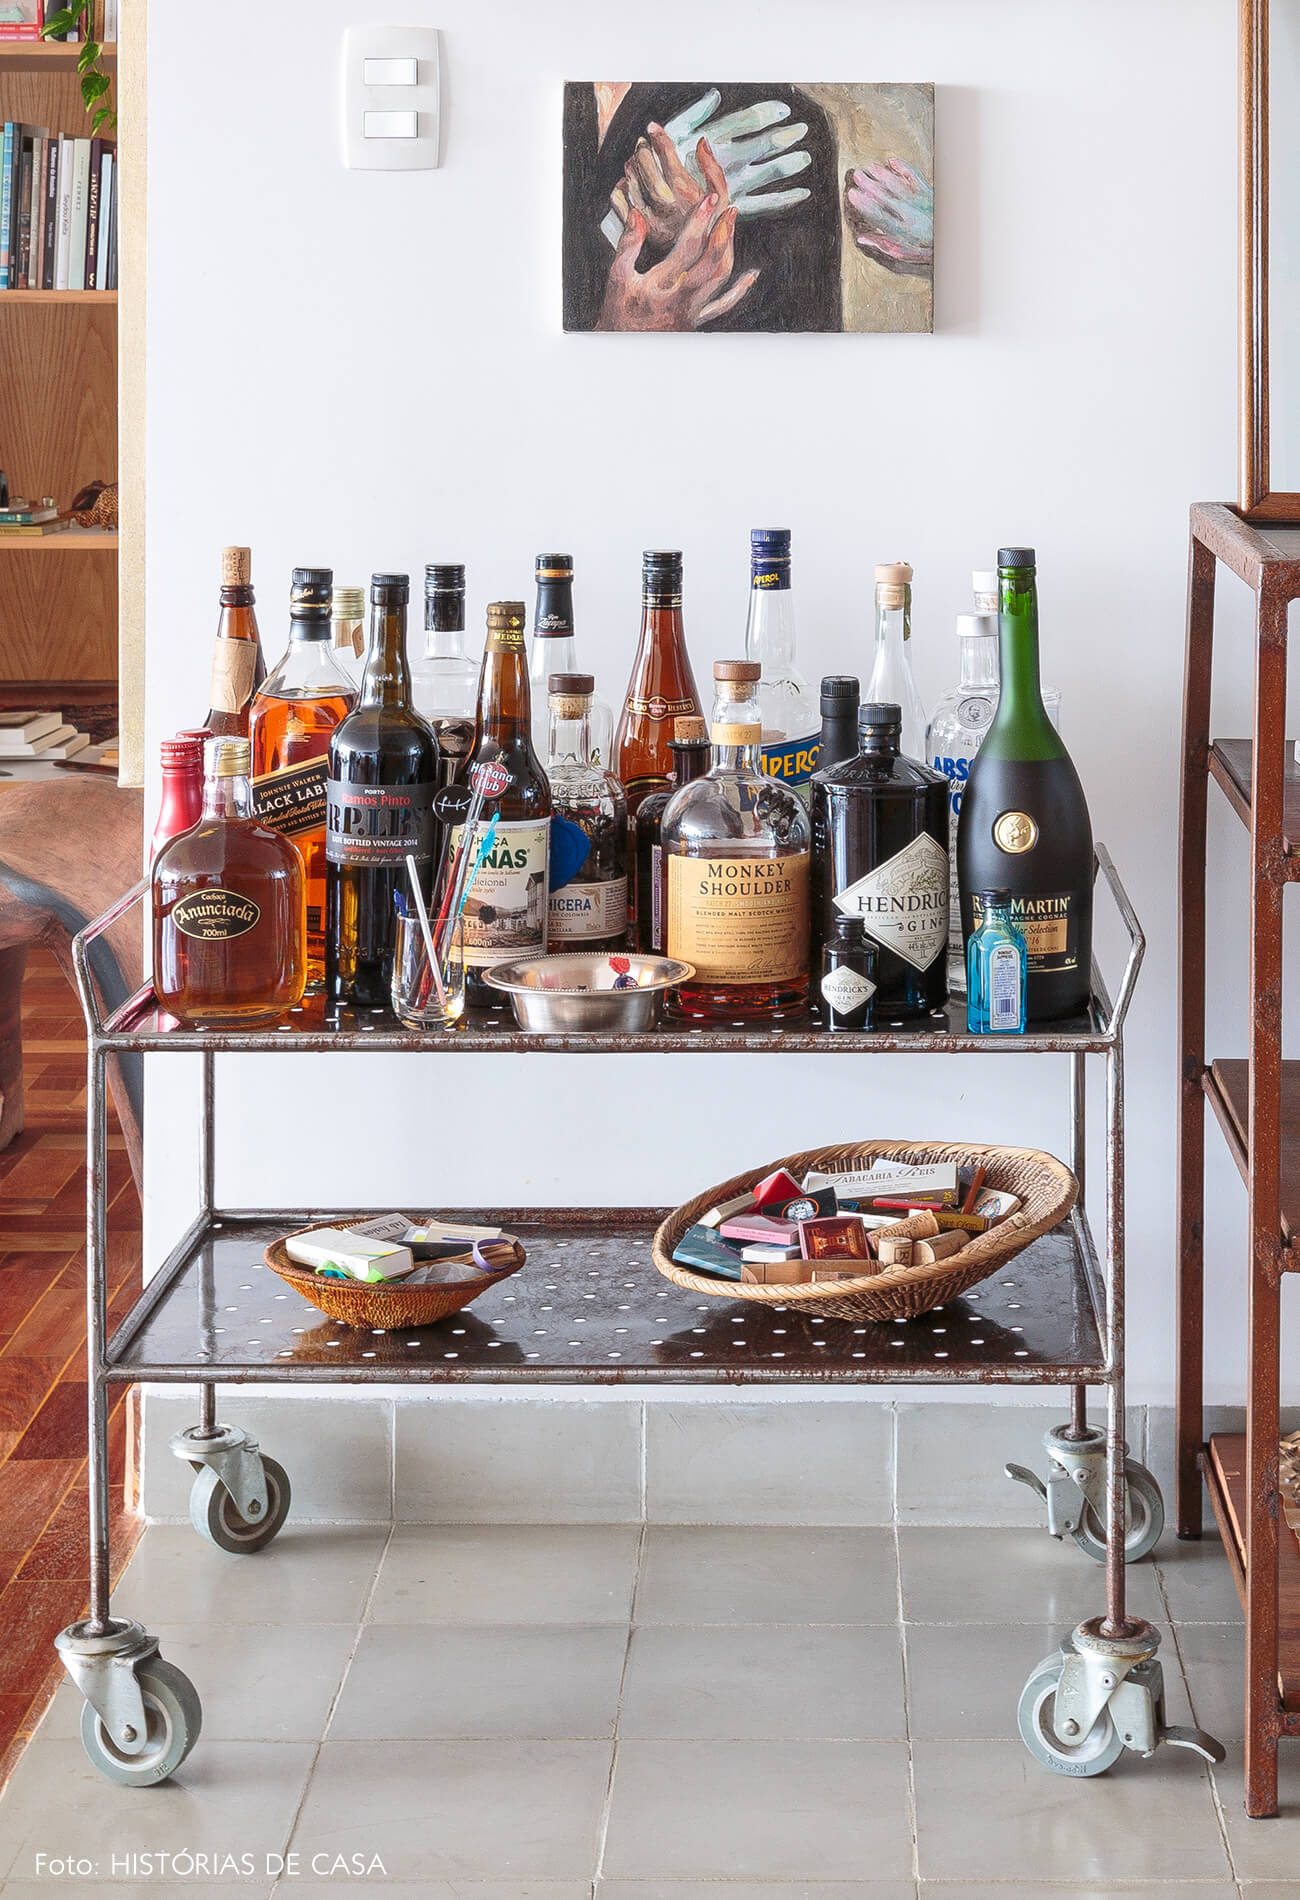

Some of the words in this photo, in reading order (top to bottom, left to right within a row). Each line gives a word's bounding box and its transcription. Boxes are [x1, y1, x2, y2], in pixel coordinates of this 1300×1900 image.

[260, 784, 291, 800] JOHNNIE
[341, 792, 377, 806] Ramos
[380, 794, 411, 806] Pinto
[343, 838, 372, 847] BOTTLED
[372, 839, 402, 847] VINTAGE
[708, 862, 786, 879] MONKEY
[699, 879, 792, 896] SHOULDER
[1010, 896, 1068, 914] MARTIN
[175, 903, 255, 924] Anunciada
[1038, 912, 1068, 920] COGNAC
[202, 928, 228, 937] 700ml
[907, 917, 938, 932] GIN
[826, 1172, 892, 1184] TABACARIA
[896, 1167, 936, 1178] REIS
